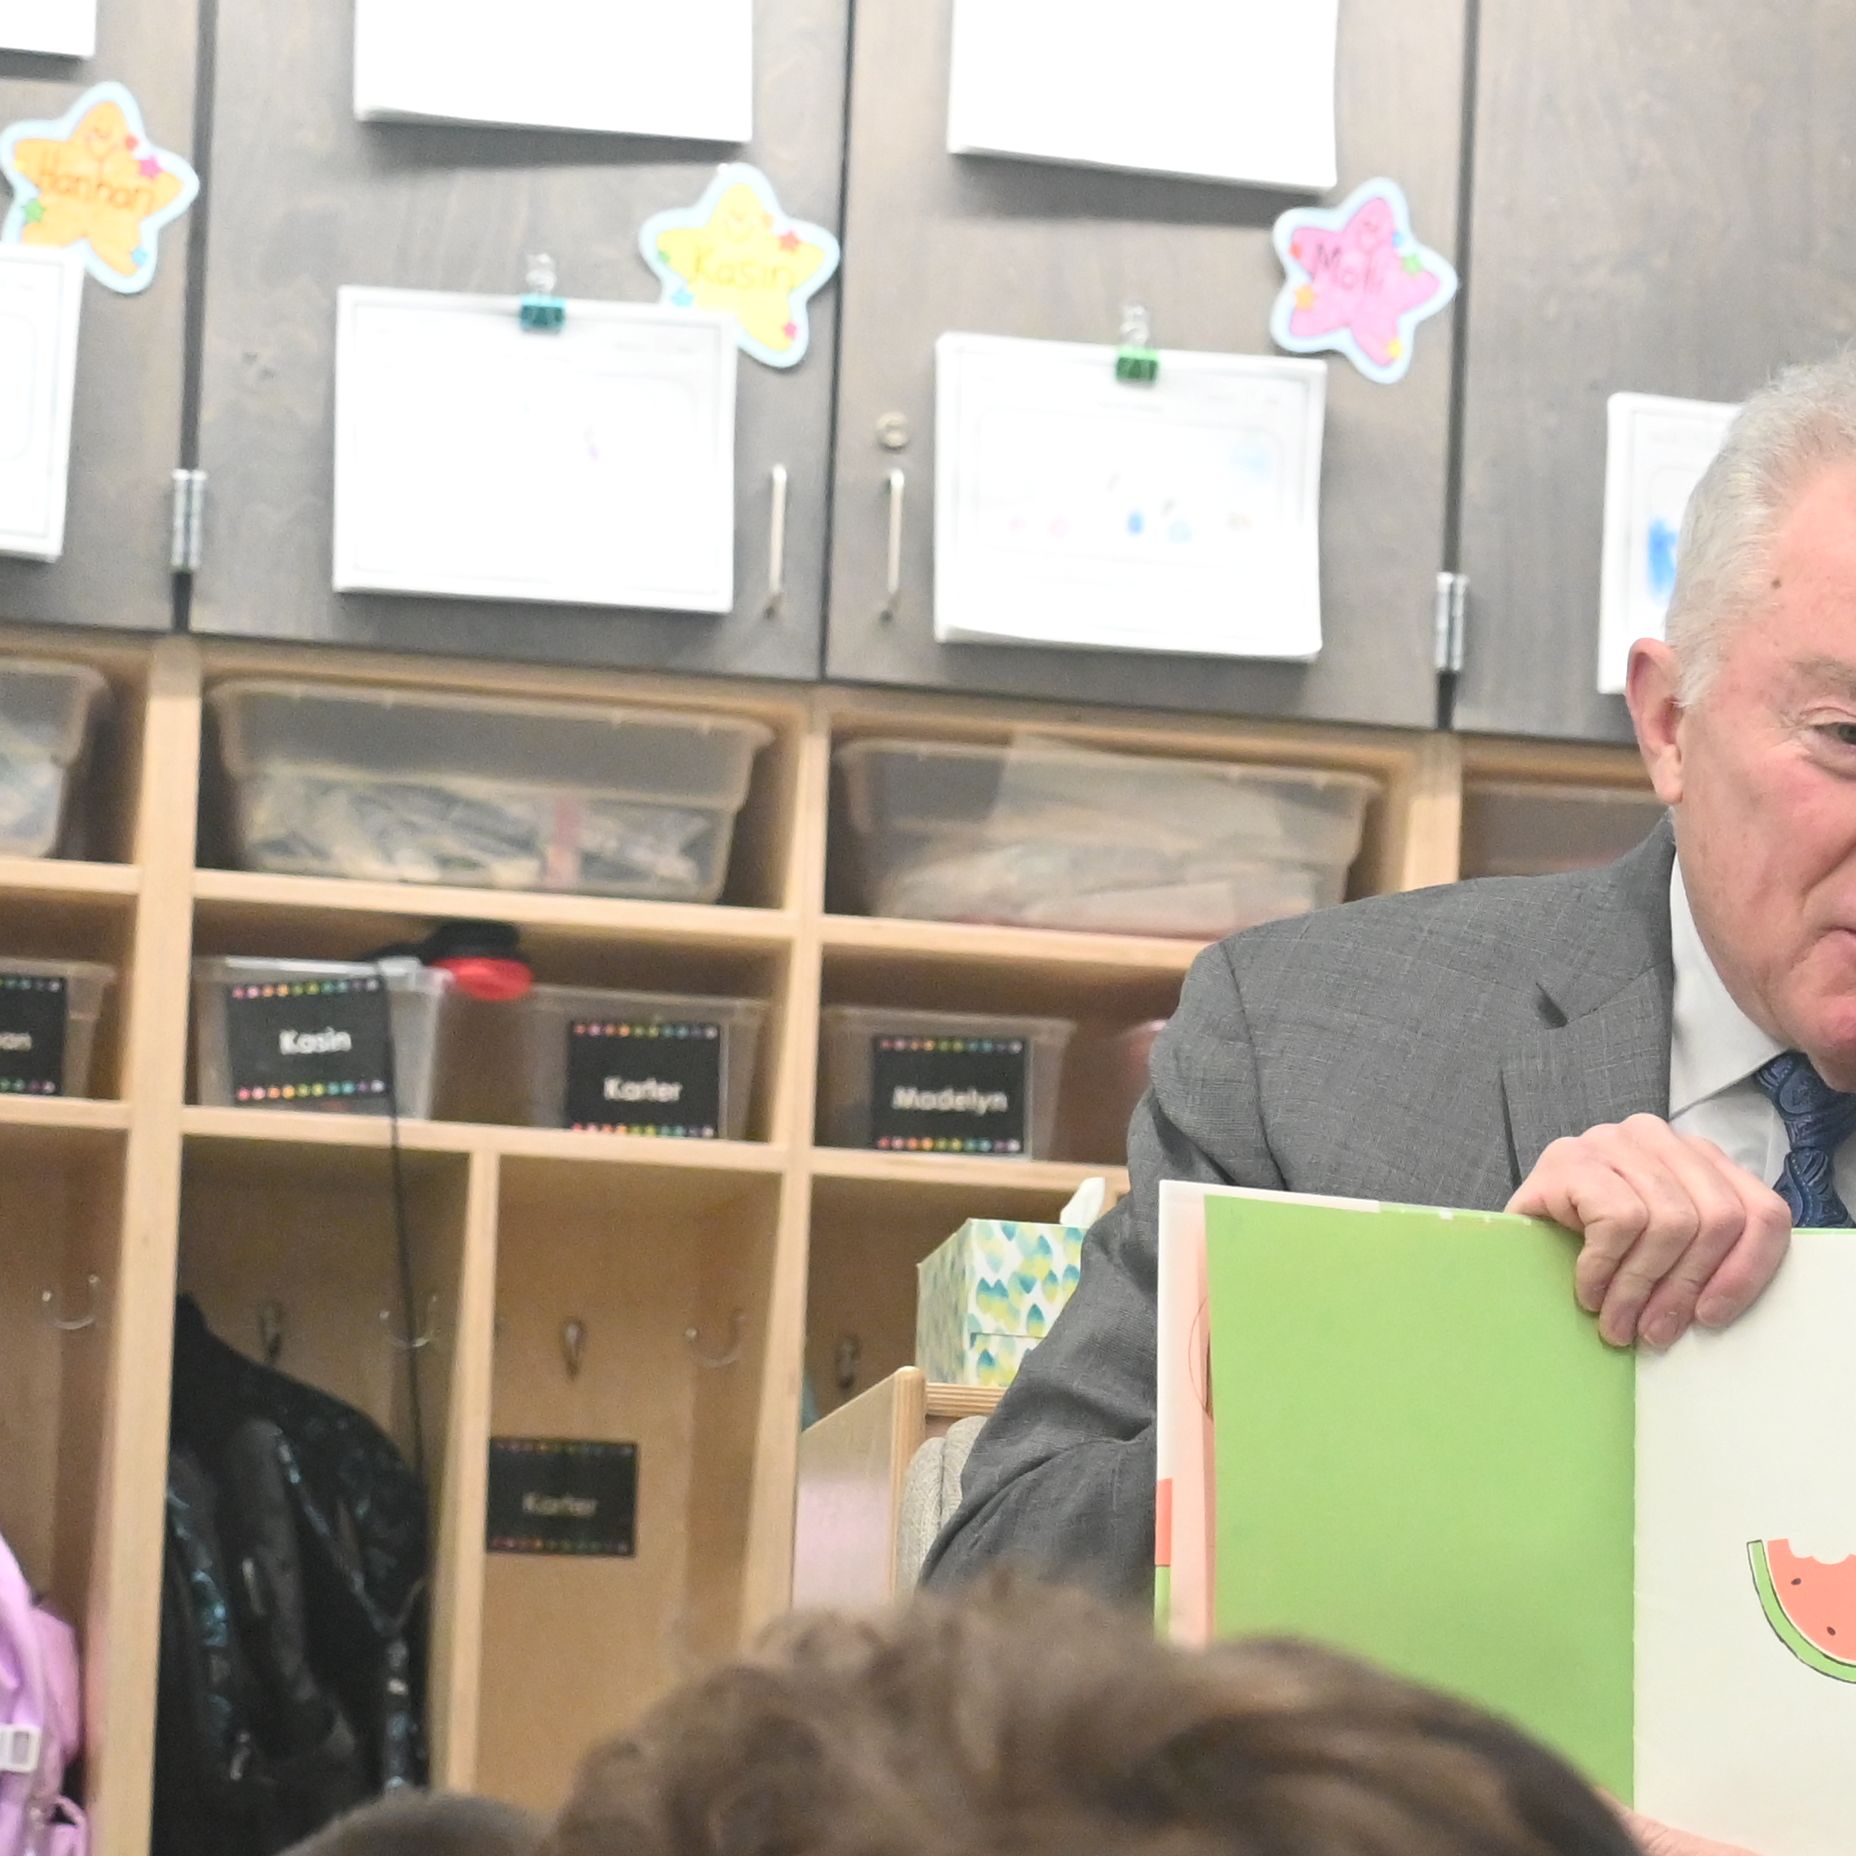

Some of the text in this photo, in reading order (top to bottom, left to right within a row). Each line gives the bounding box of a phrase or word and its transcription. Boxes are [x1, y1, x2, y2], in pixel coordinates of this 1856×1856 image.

[278, 1026, 352, 1056] Kasin
[603, 1075, 683, 1103] Karter
[892, 1086, 1008, 1115] Madelyn
